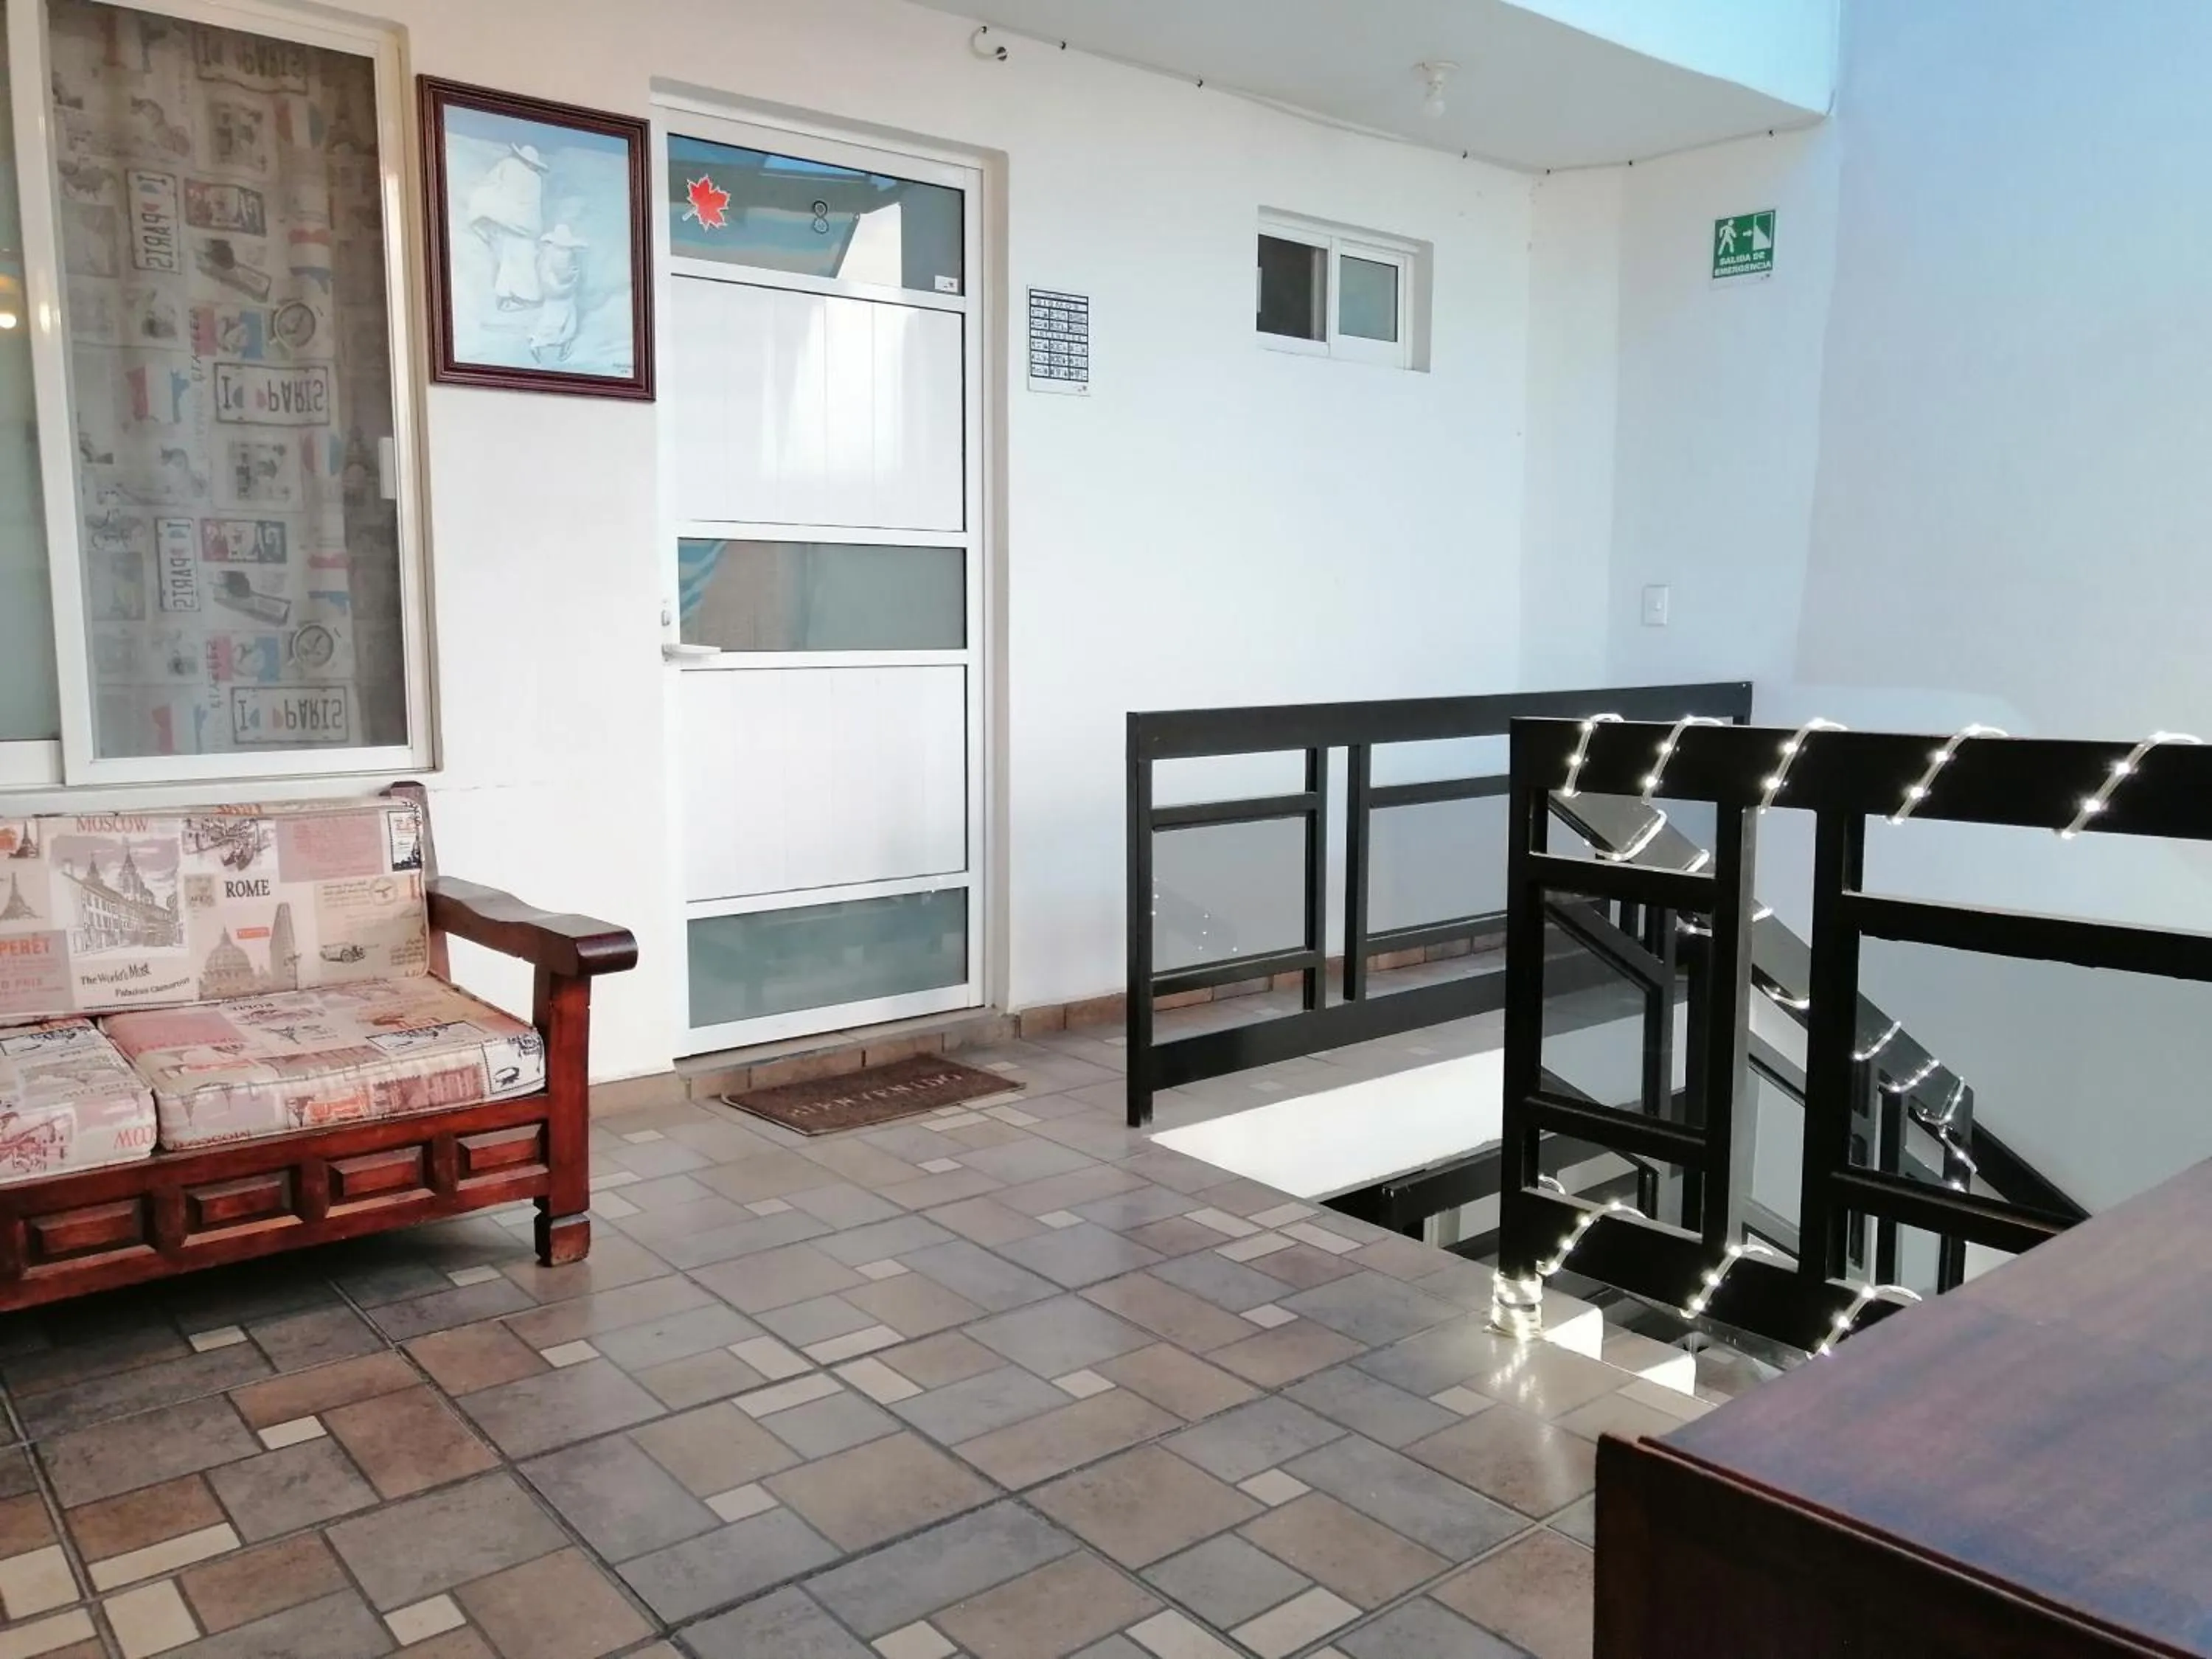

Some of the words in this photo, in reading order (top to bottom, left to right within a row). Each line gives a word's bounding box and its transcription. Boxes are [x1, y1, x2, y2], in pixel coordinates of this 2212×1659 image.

[812, 199, 829, 234] 8
[1719, 253, 1750, 266] SALIDA
[1752, 251, 1766, 260] DE
[1714, 261, 1772, 276] EMERGENCIA
[76, 815, 149, 833] MOSCOW
[224, 879, 271, 899] ROME
[80, 975, 97, 986] The
[128, 961, 152, 978] Most
